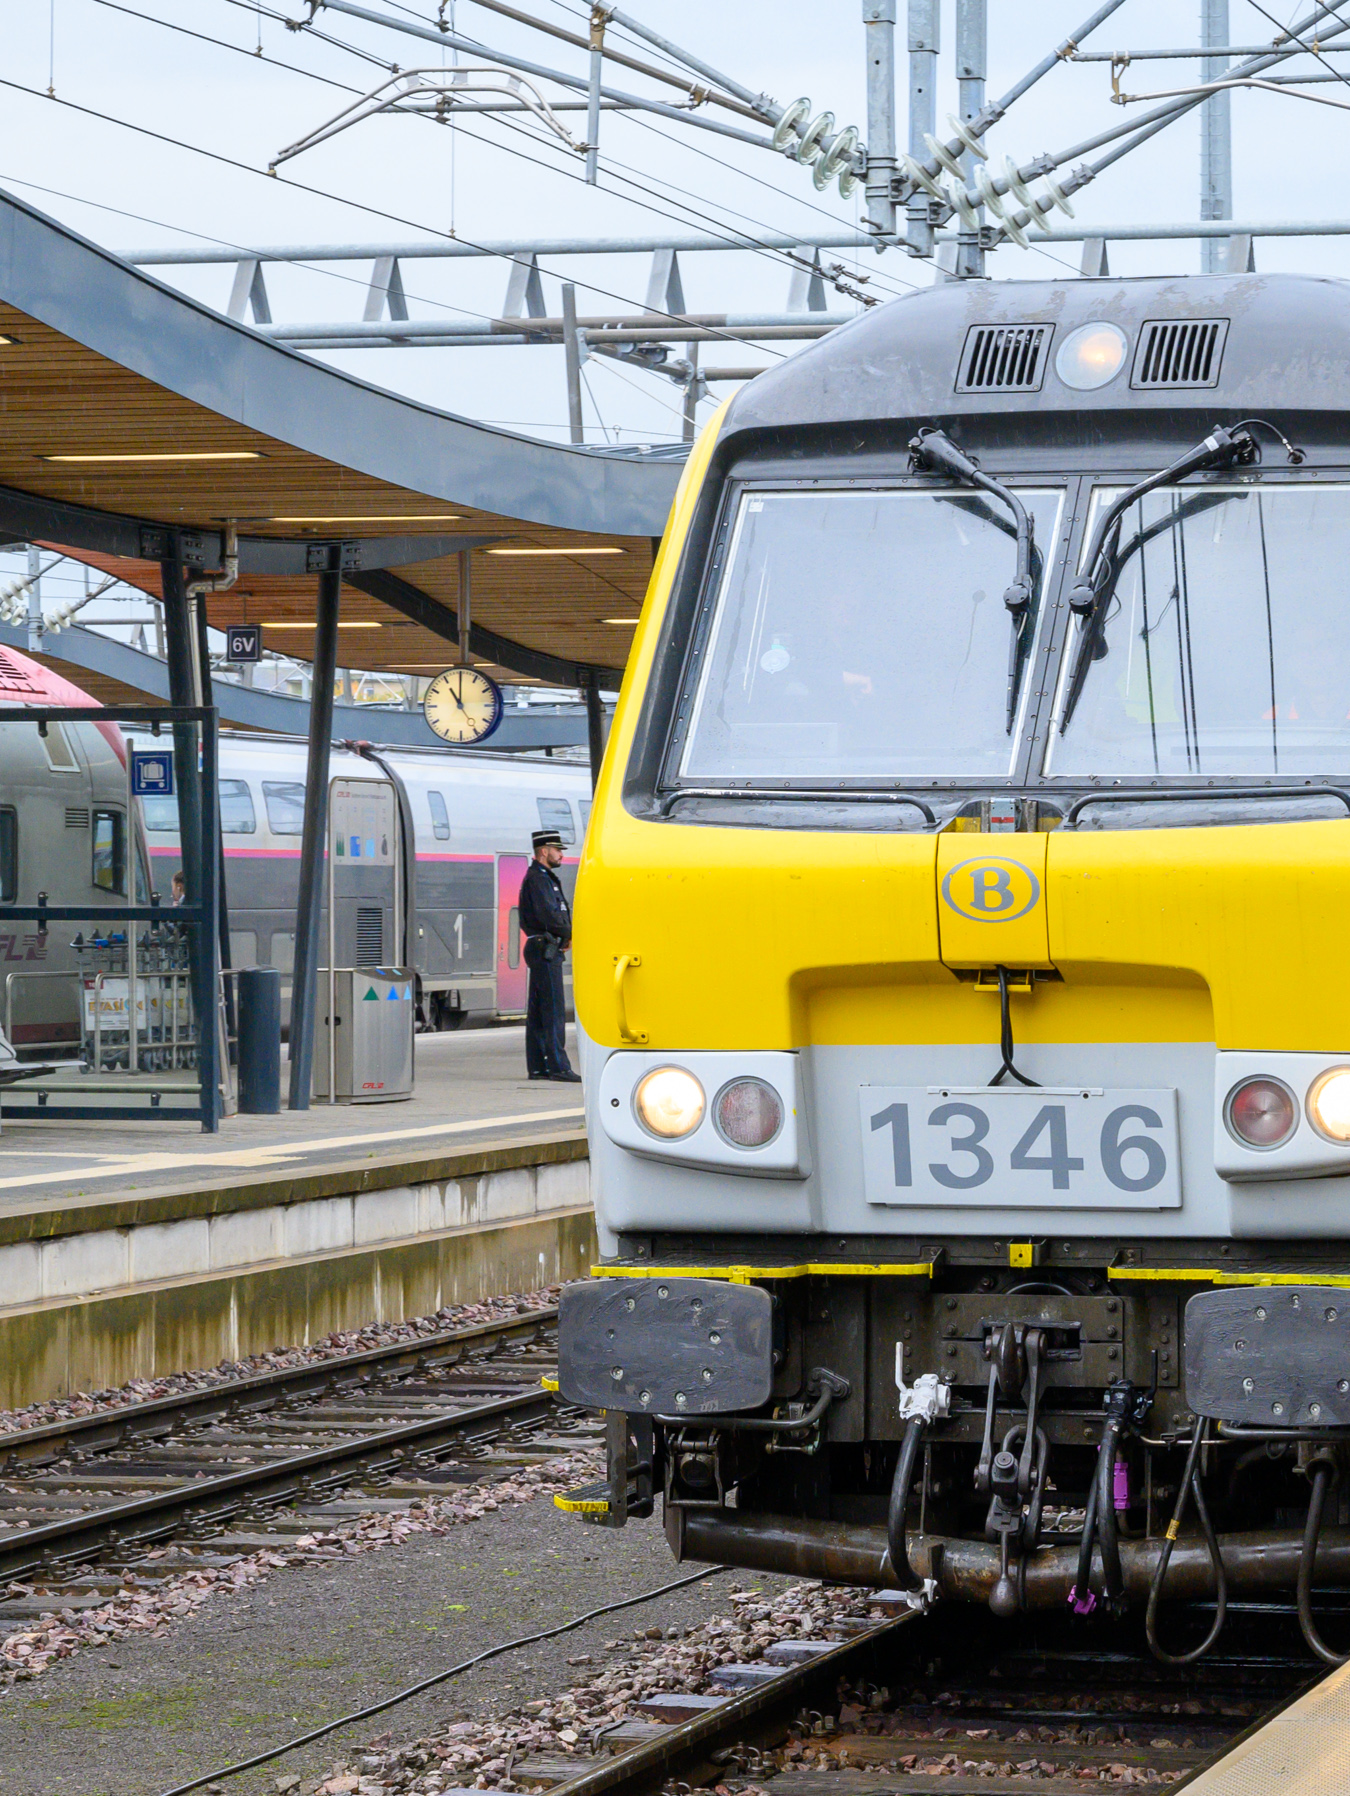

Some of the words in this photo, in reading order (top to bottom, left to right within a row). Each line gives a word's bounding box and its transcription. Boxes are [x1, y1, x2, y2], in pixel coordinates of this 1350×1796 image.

[232, 637, 255, 652] 6V
[969, 866, 1015, 913] B
[454, 914, 463, 959] 1
[870, 1102, 1167, 1192] 1346
